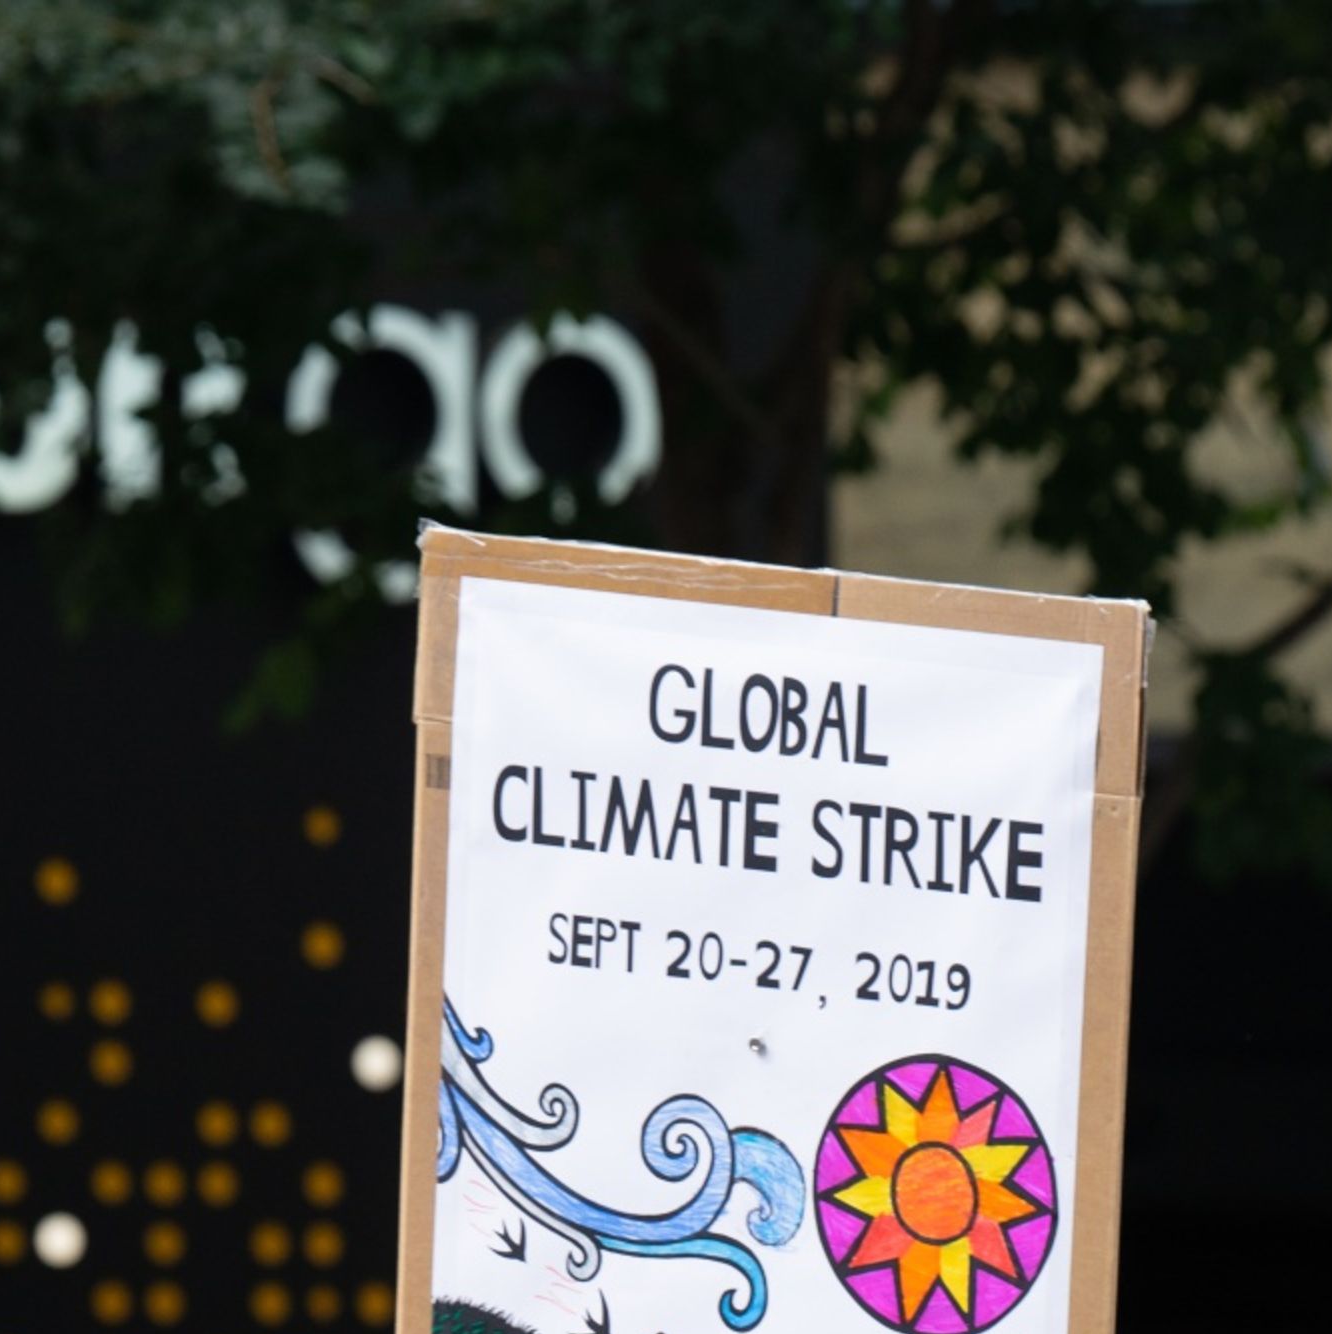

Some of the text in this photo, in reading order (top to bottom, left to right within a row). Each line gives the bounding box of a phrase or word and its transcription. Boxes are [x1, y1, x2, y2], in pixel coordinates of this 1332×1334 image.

[649, 663, 889, 767] GLOBAL
[492, 763, 1044, 903] CLIMATE STRIKE
[547, 911, 972, 1011] SEPT 20-27, 2019
